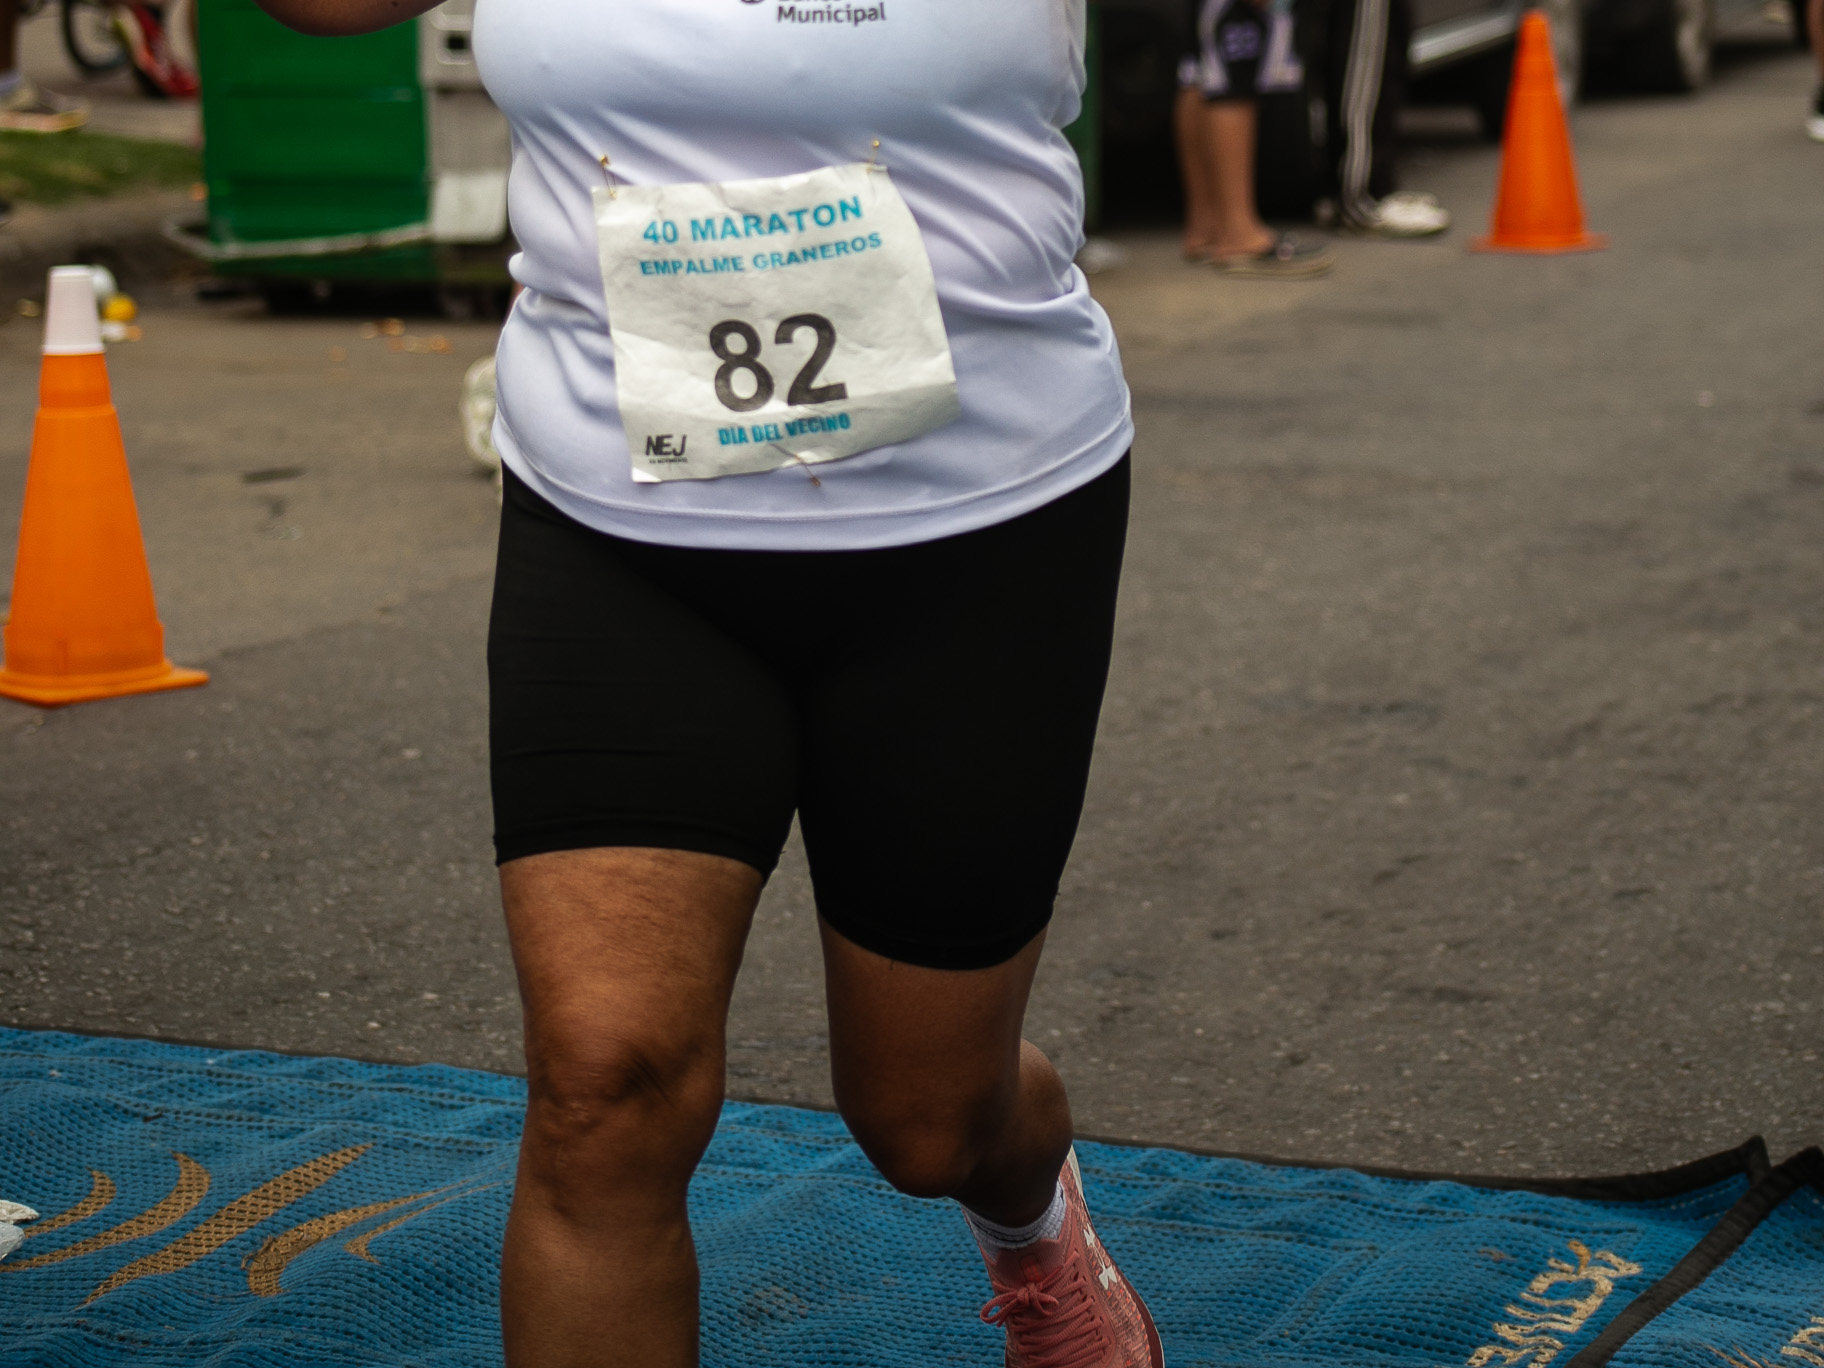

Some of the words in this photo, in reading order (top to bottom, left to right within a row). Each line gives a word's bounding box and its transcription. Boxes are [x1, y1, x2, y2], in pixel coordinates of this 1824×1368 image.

[777, 2, 887, 27] Municipal
[642, 220, 680, 245] 40
[690, 195, 863, 243] MARATON
[639, 256, 744, 277] EMPALME
[752, 232, 883, 271] GRANEROS
[708, 312, 849, 413] 82
[645, 433, 688, 457] NEJ
[751, 420, 784, 444] DEL
[786, 412, 852, 437] VECINO
